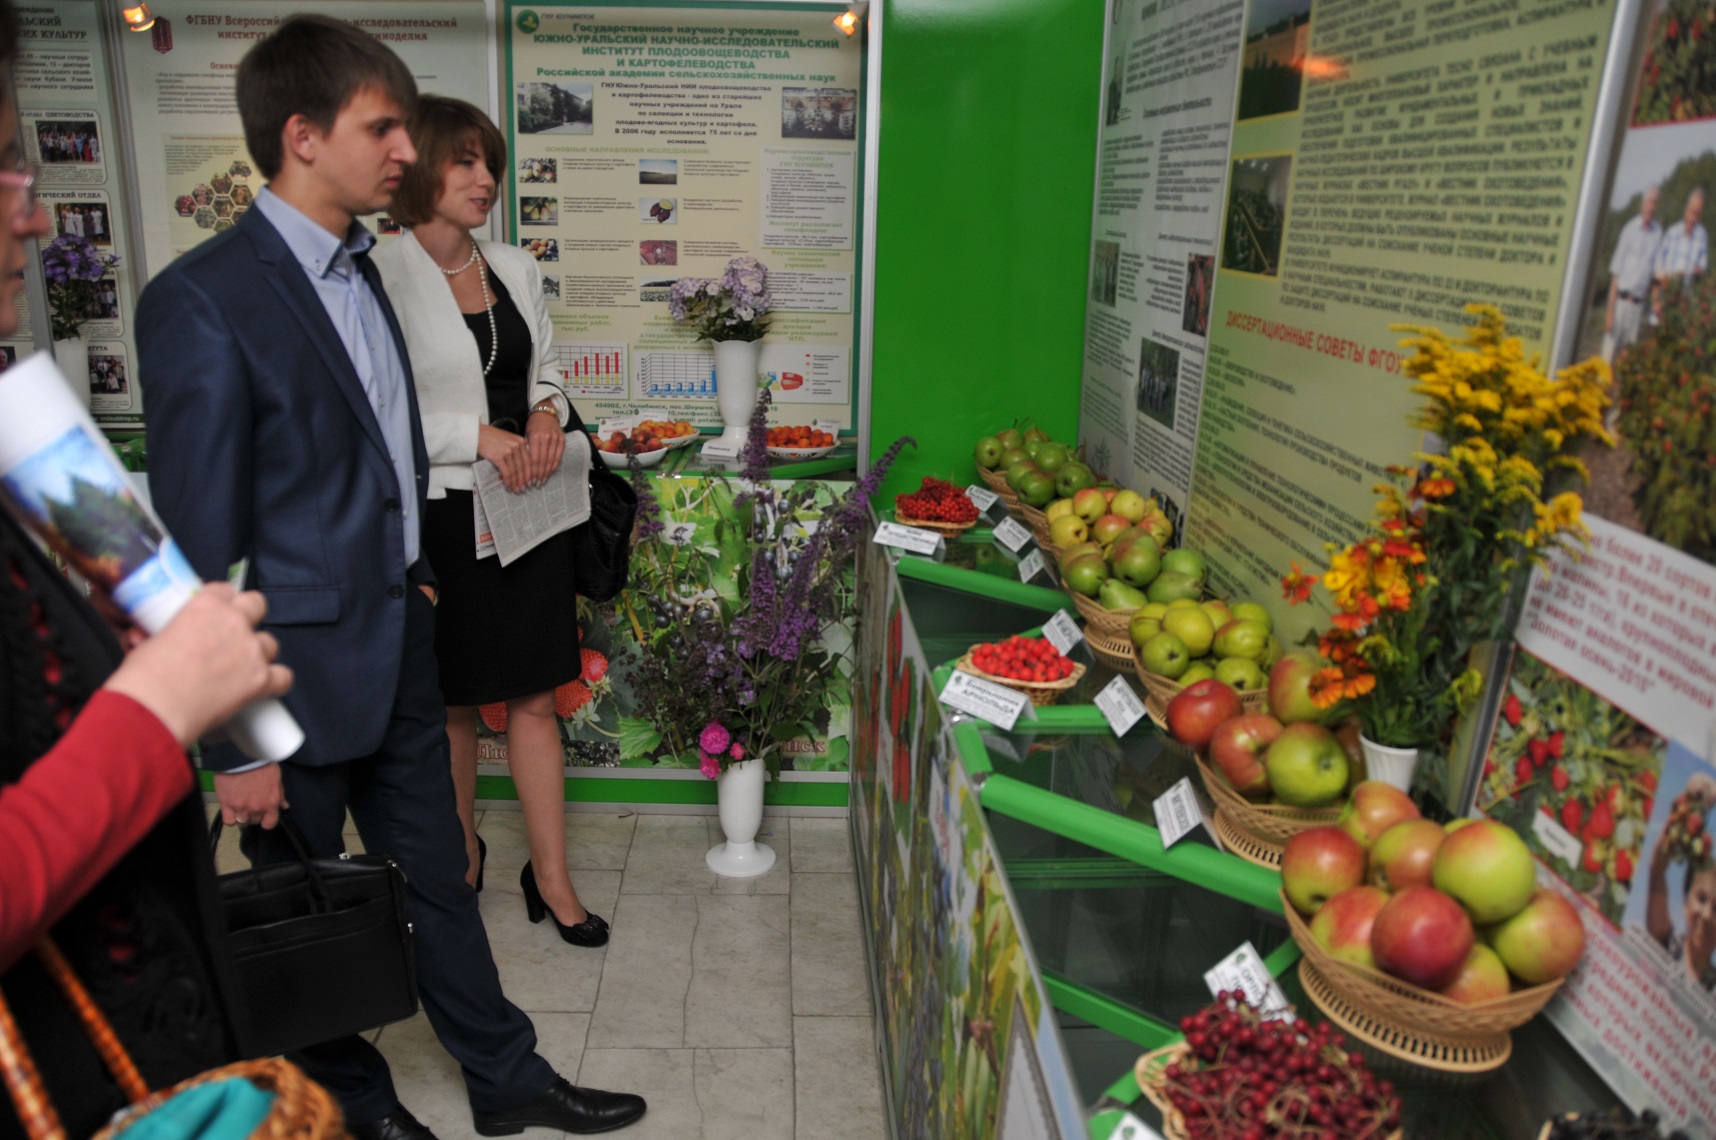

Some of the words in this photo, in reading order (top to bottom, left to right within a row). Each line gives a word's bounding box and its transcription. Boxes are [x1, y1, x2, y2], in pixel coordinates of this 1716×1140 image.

[186, 14, 222, 26] ФГБНУ
[225, 15, 280, 28] Всероссий
[41, 30, 86, 39] КУЛЬТУР
[573, 23, 673, 33] Государственное
[677, 26, 725, 35] научное
[728, 27, 799, 36] учреждение
[373, 32, 427, 42] иноделия
[534, 33, 647, 44] ЮЖНО-УРАЛЬСКИЙ
[651, 35, 839, 49] НАУЧНО-ИССЛЕДОВАТЕЛЬСКИЙ
[582, 47, 643, 55] ИНСТИТУТ
[648, 47, 790, 59] ПЛОДООВОЩЕВОДСТВА
[629, 59, 755, 69] КАРТОФЕЛЕВОДСТВА
[537, 68, 605, 77] Российской
[609, 70, 665, 78] академии
[668, 71, 805, 81] сельскохозяйственных
[809, 74, 836, 82] наук
[1225, 310, 1313, 350] ДИССЕРТАЦИОННЫЕ
[1317, 334, 1365, 363] СОВЕТЫ
